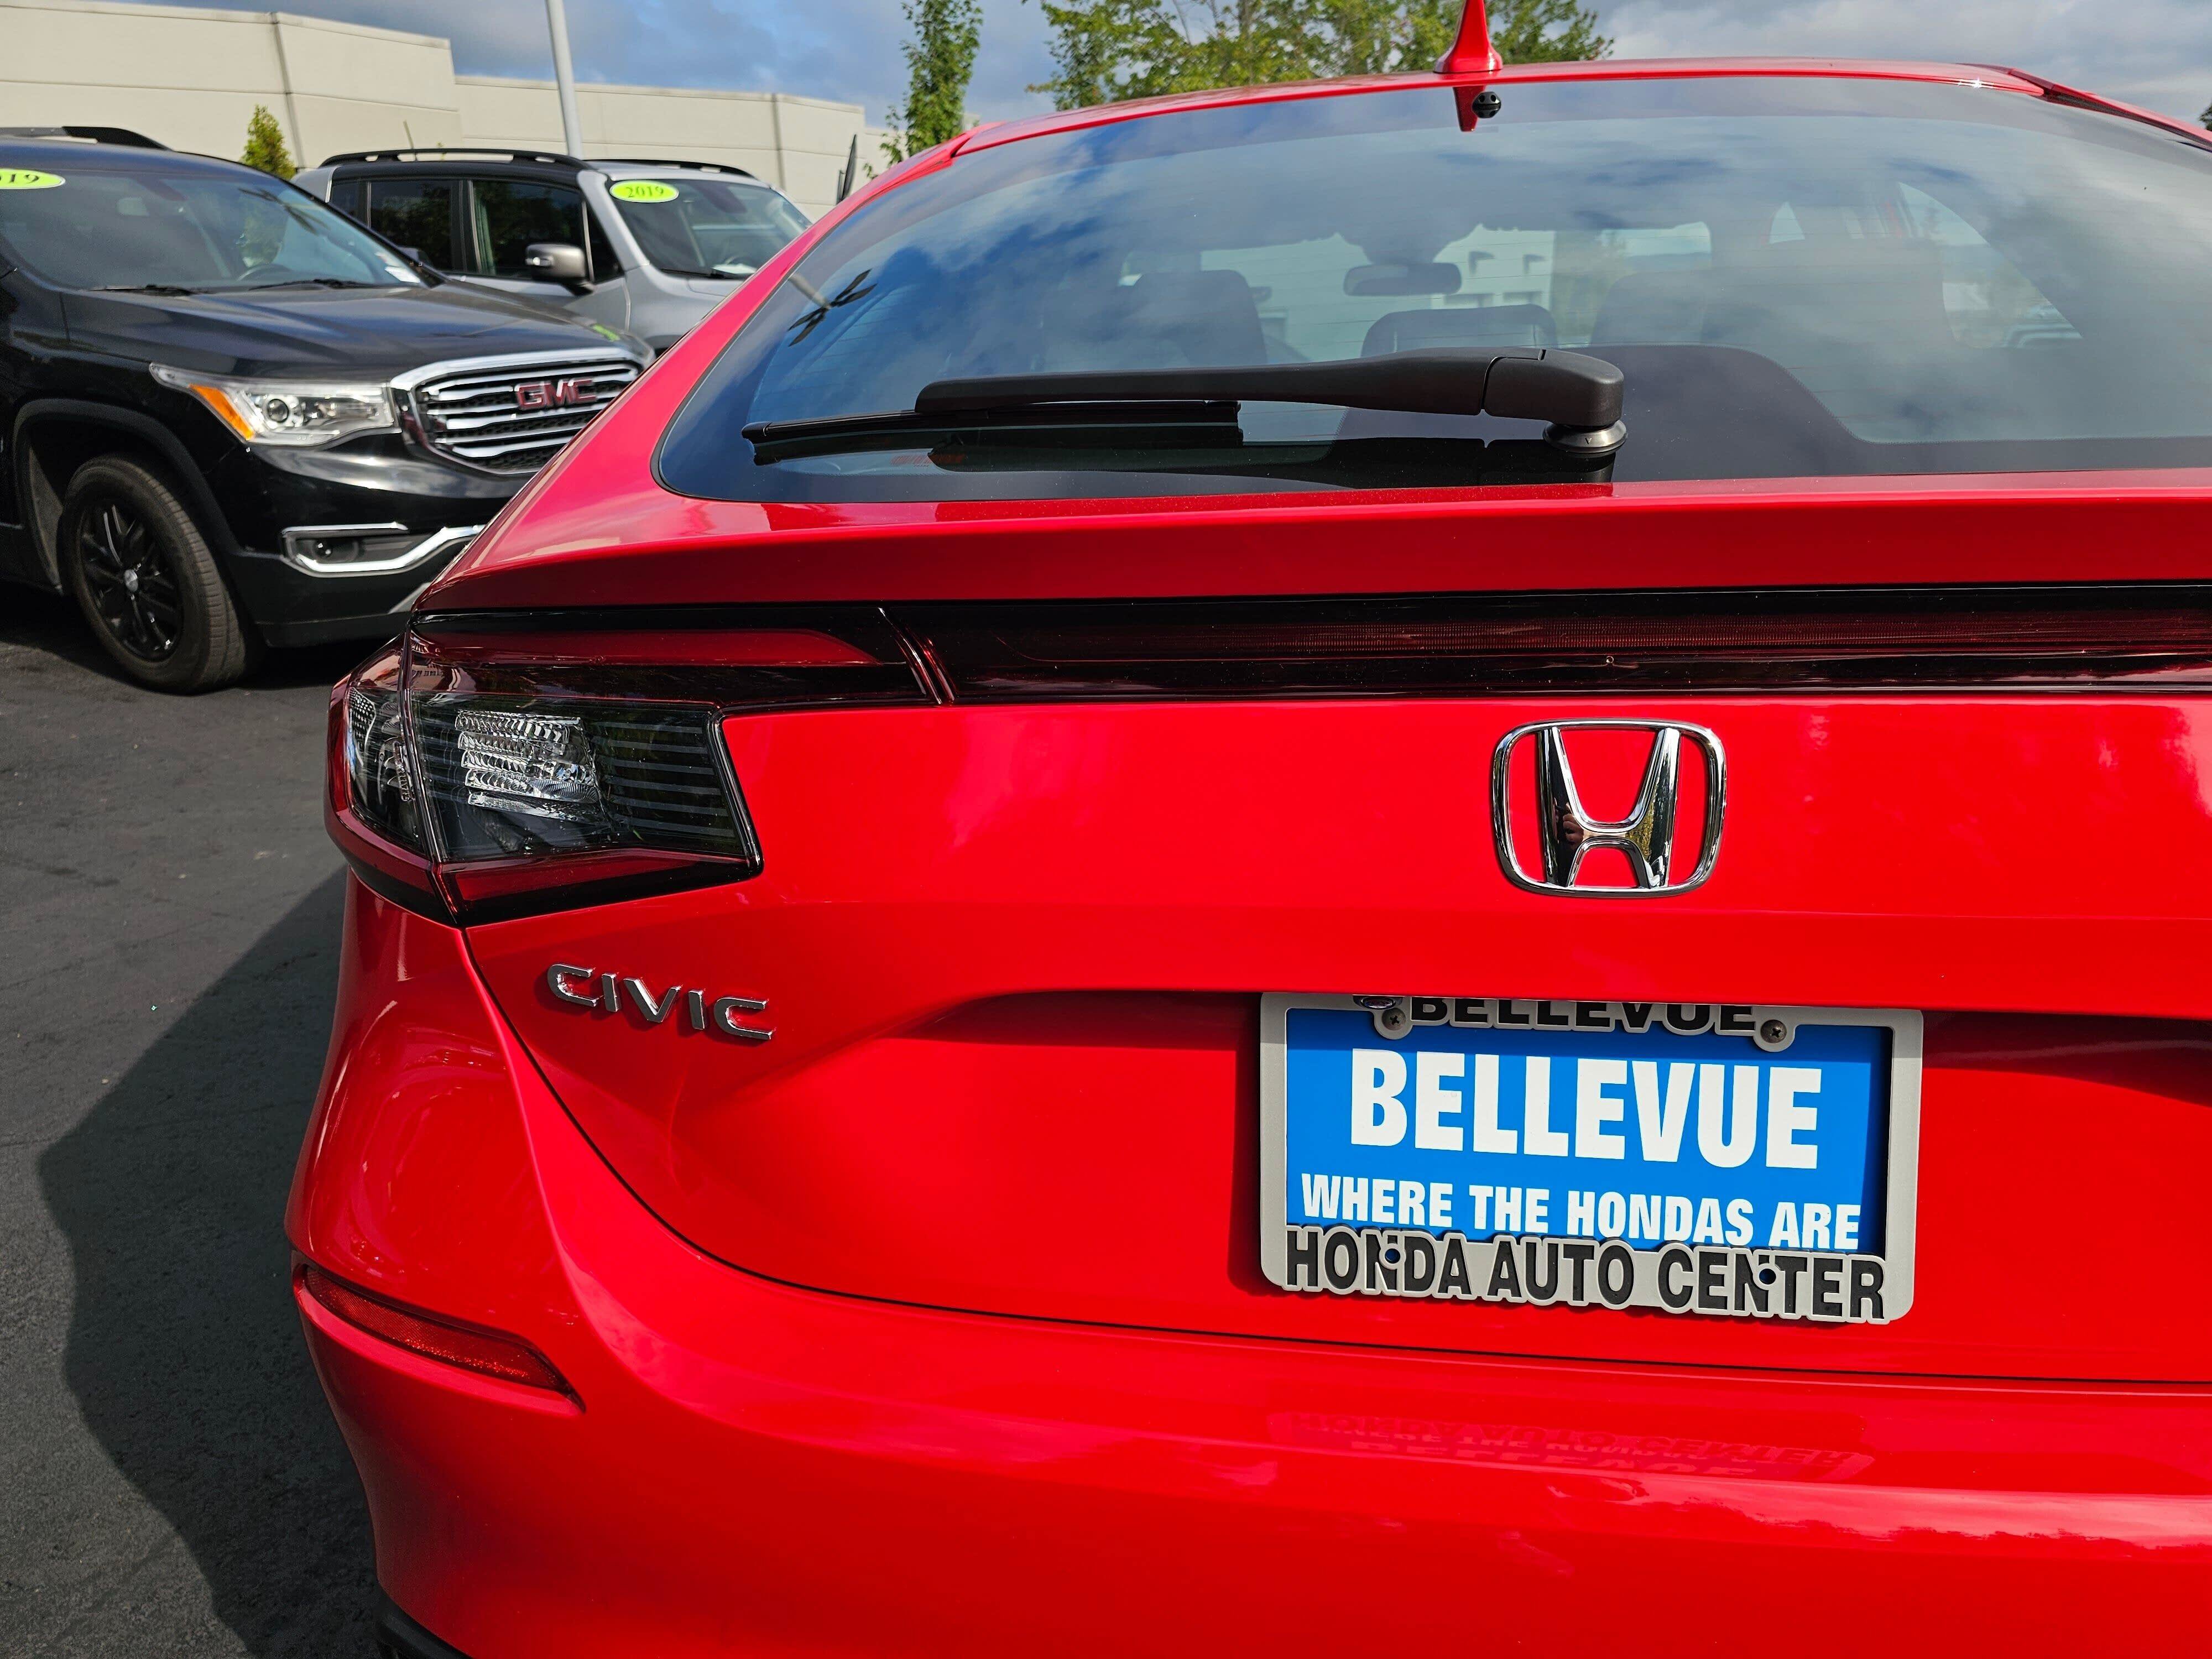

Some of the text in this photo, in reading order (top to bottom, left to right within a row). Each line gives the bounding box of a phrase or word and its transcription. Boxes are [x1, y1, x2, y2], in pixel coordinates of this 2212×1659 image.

[0, 173, 39, 184] 19
[625, 186, 664, 198] 2019
[516, 378, 597, 410] GMC
[547, 963, 775, 1040] CIVIC
[1411, 997, 1756, 1031] BELLEVUE
[1350, 1048, 1822, 1169] BELLEVUE
[1301, 1172, 1861, 1249] WHERE THE HONDAS ARE
[1286, 1227, 1885, 1319] HONDA AUTO CENTER
